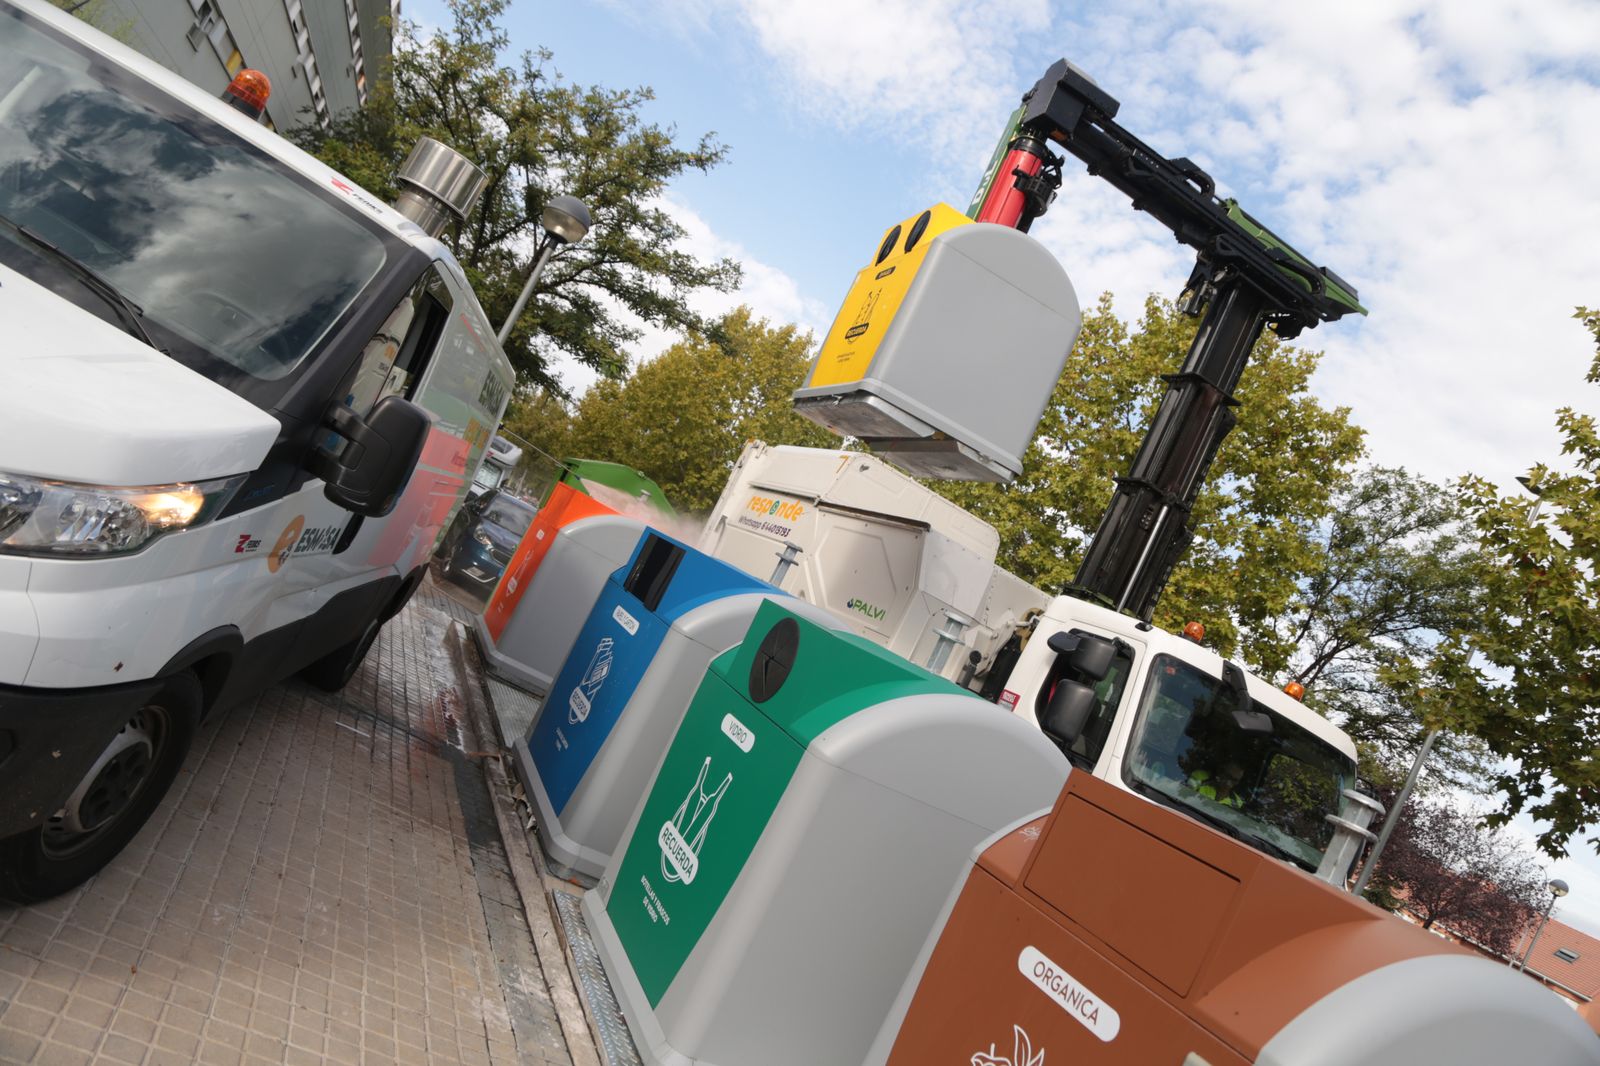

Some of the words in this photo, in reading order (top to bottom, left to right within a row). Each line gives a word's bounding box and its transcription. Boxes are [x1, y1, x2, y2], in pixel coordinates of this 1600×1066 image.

[854, 599, 886, 621] PALVI
[729, 720, 748, 744] VIDRIO
[661, 827, 694, 879] RECUERDA
[641, 874, 656, 900] BOTELLAS
[656, 899, 670, 926] FRASCOS
[647, 902, 658, 923] VIDRIO
[1033, 960, 1100, 1026] ORGANICA
